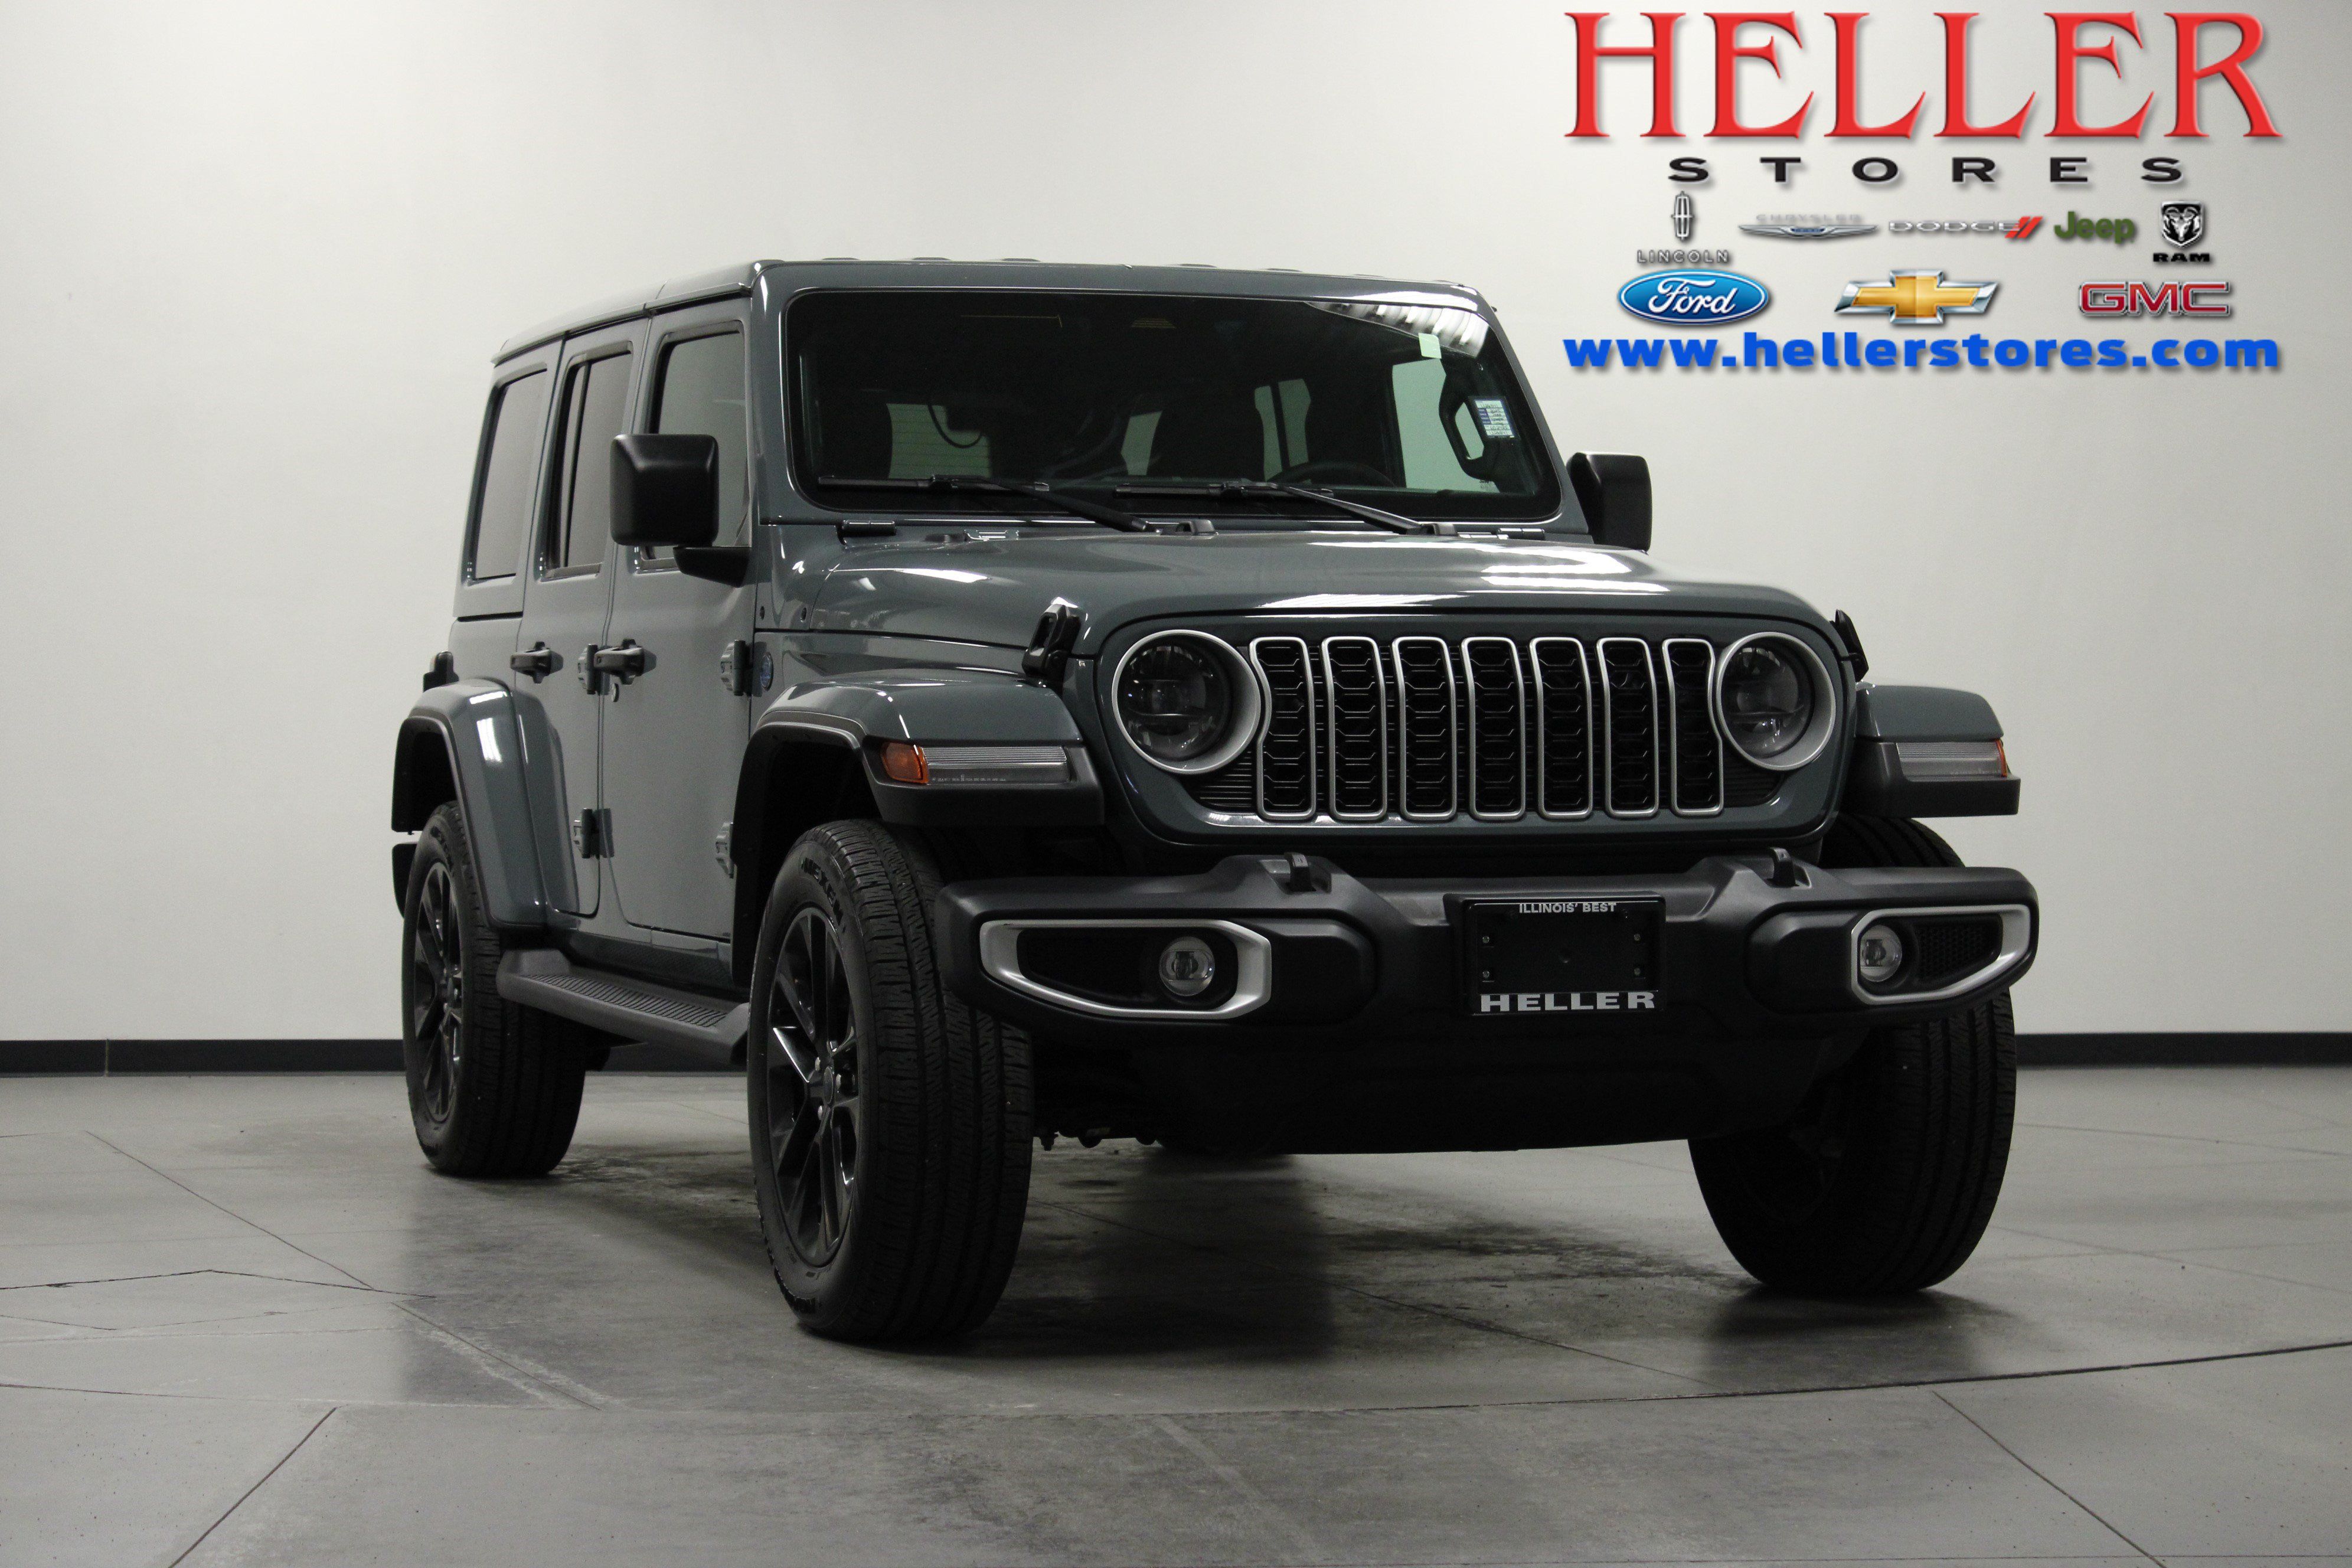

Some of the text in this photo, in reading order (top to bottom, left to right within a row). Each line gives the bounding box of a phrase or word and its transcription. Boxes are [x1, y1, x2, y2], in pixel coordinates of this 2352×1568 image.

[1519, 902, 1616, 913] ILLINOIS' BEST
[1480, 991, 1655, 1012] HELLER
